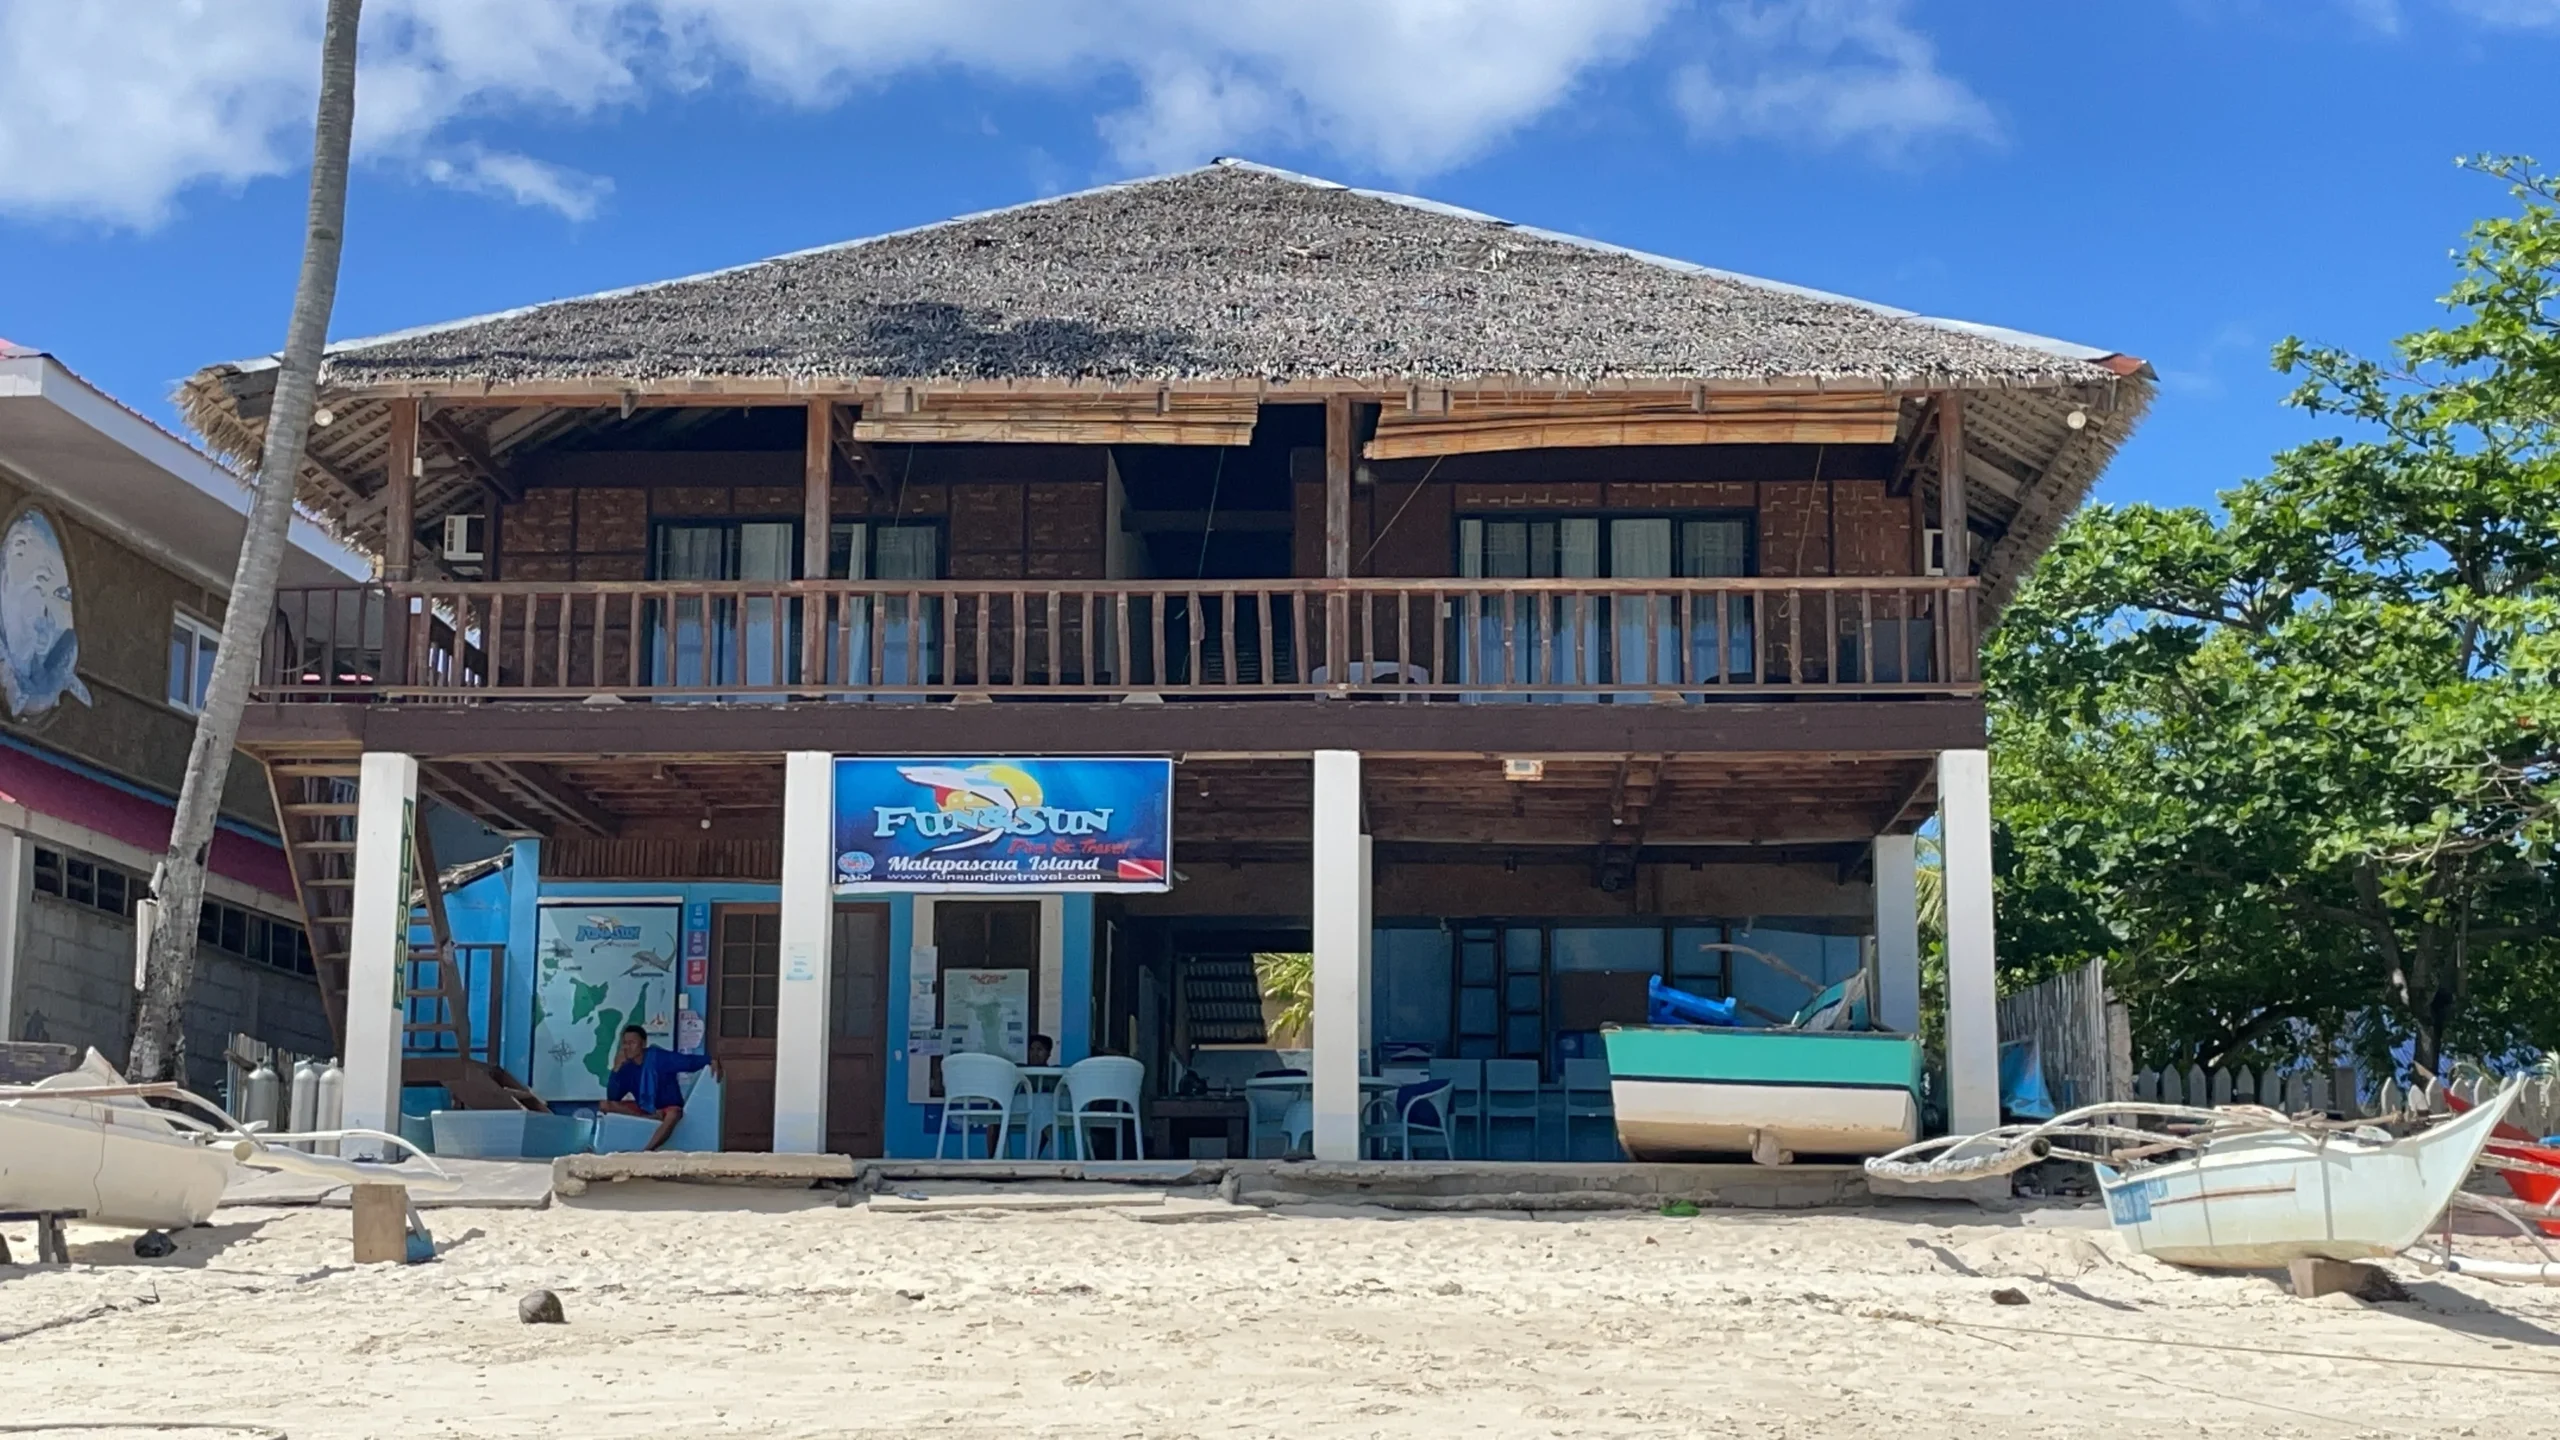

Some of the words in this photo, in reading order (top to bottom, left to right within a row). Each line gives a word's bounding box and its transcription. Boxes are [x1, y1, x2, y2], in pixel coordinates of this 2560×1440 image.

[887, 855, 1019, 874] Malapascua
[1028, 855, 1100, 871] Island
[886, 872, 1102, 882] www.funsundivetravel.com
[394, 802, 413, 1005] NITROX
